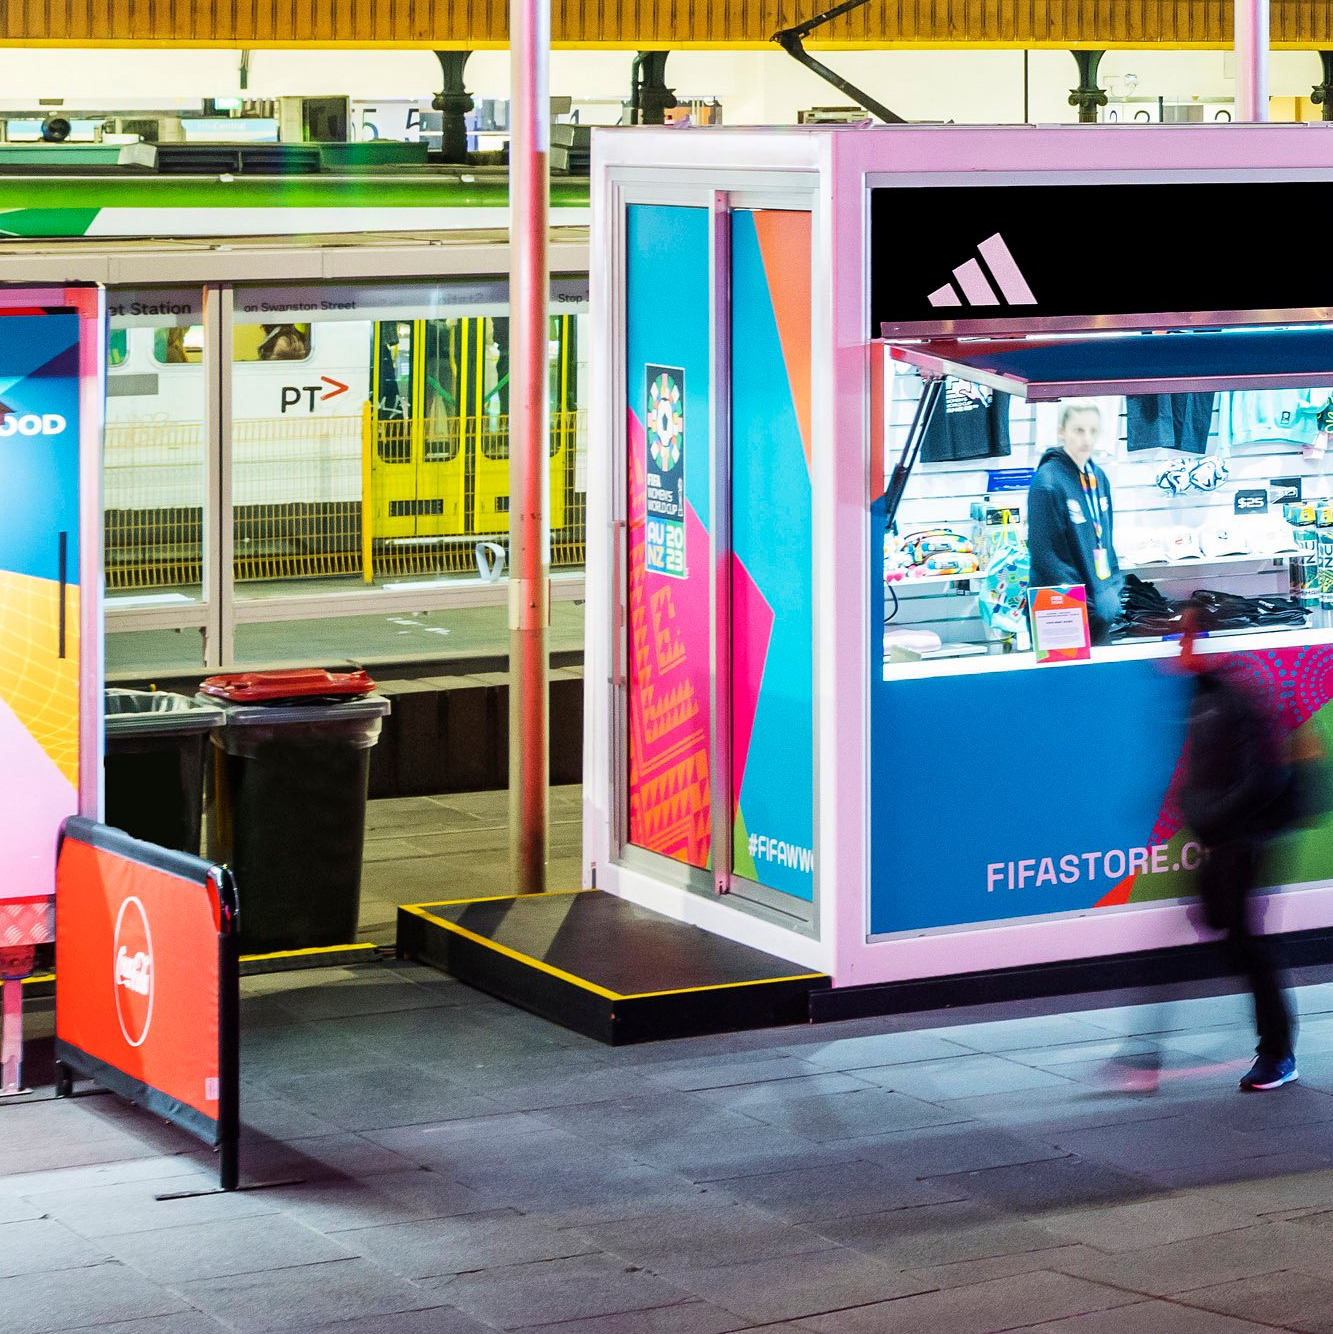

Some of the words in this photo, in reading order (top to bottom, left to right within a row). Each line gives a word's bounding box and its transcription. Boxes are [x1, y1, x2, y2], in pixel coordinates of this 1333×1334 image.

[127, 300, 191, 318] Station
[244, 304, 259, 313] on
[262, 302, 318, 314] Swanston
[321, 300, 356, 311] Street
[558, 293, 583, 305] Stop
[281, 386, 323, 413] PT
[1237, 497, 1265, 509] $25
[647, 521, 665, 545] AU
[666, 525, 684, 548] 20
[666, 548, 684, 572] 23
[748, 832, 814, 874] #FIFAWW
[987, 841, 1202, 893] FIFASTORE.C
